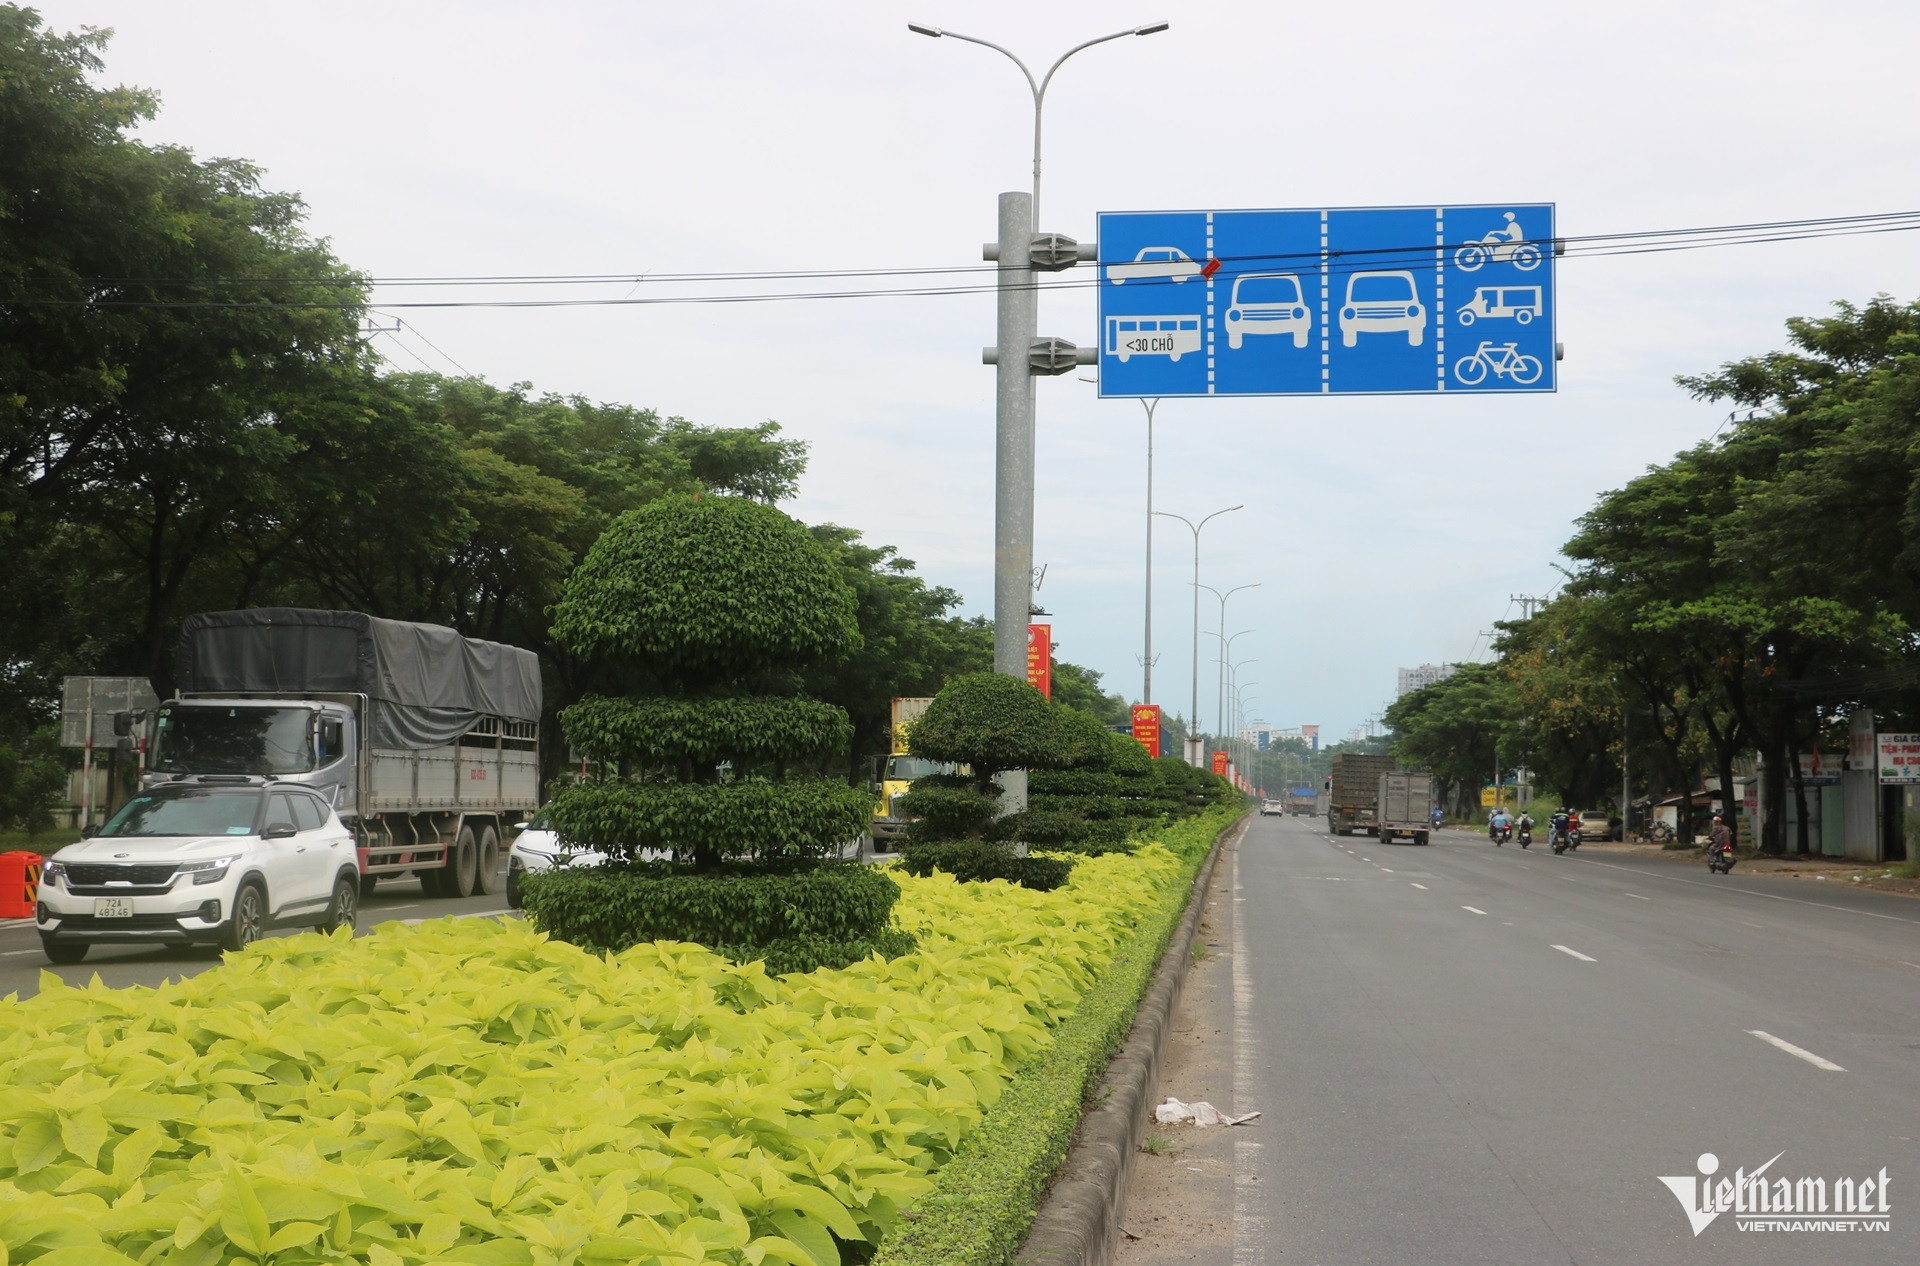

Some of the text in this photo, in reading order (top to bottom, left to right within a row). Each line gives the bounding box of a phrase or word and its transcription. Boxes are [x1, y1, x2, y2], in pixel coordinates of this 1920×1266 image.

[1126, 333, 1174, 351] <30 CHỖ
[106, 899, 122, 908] 72A
[99, 908, 128, 917] 483.46
